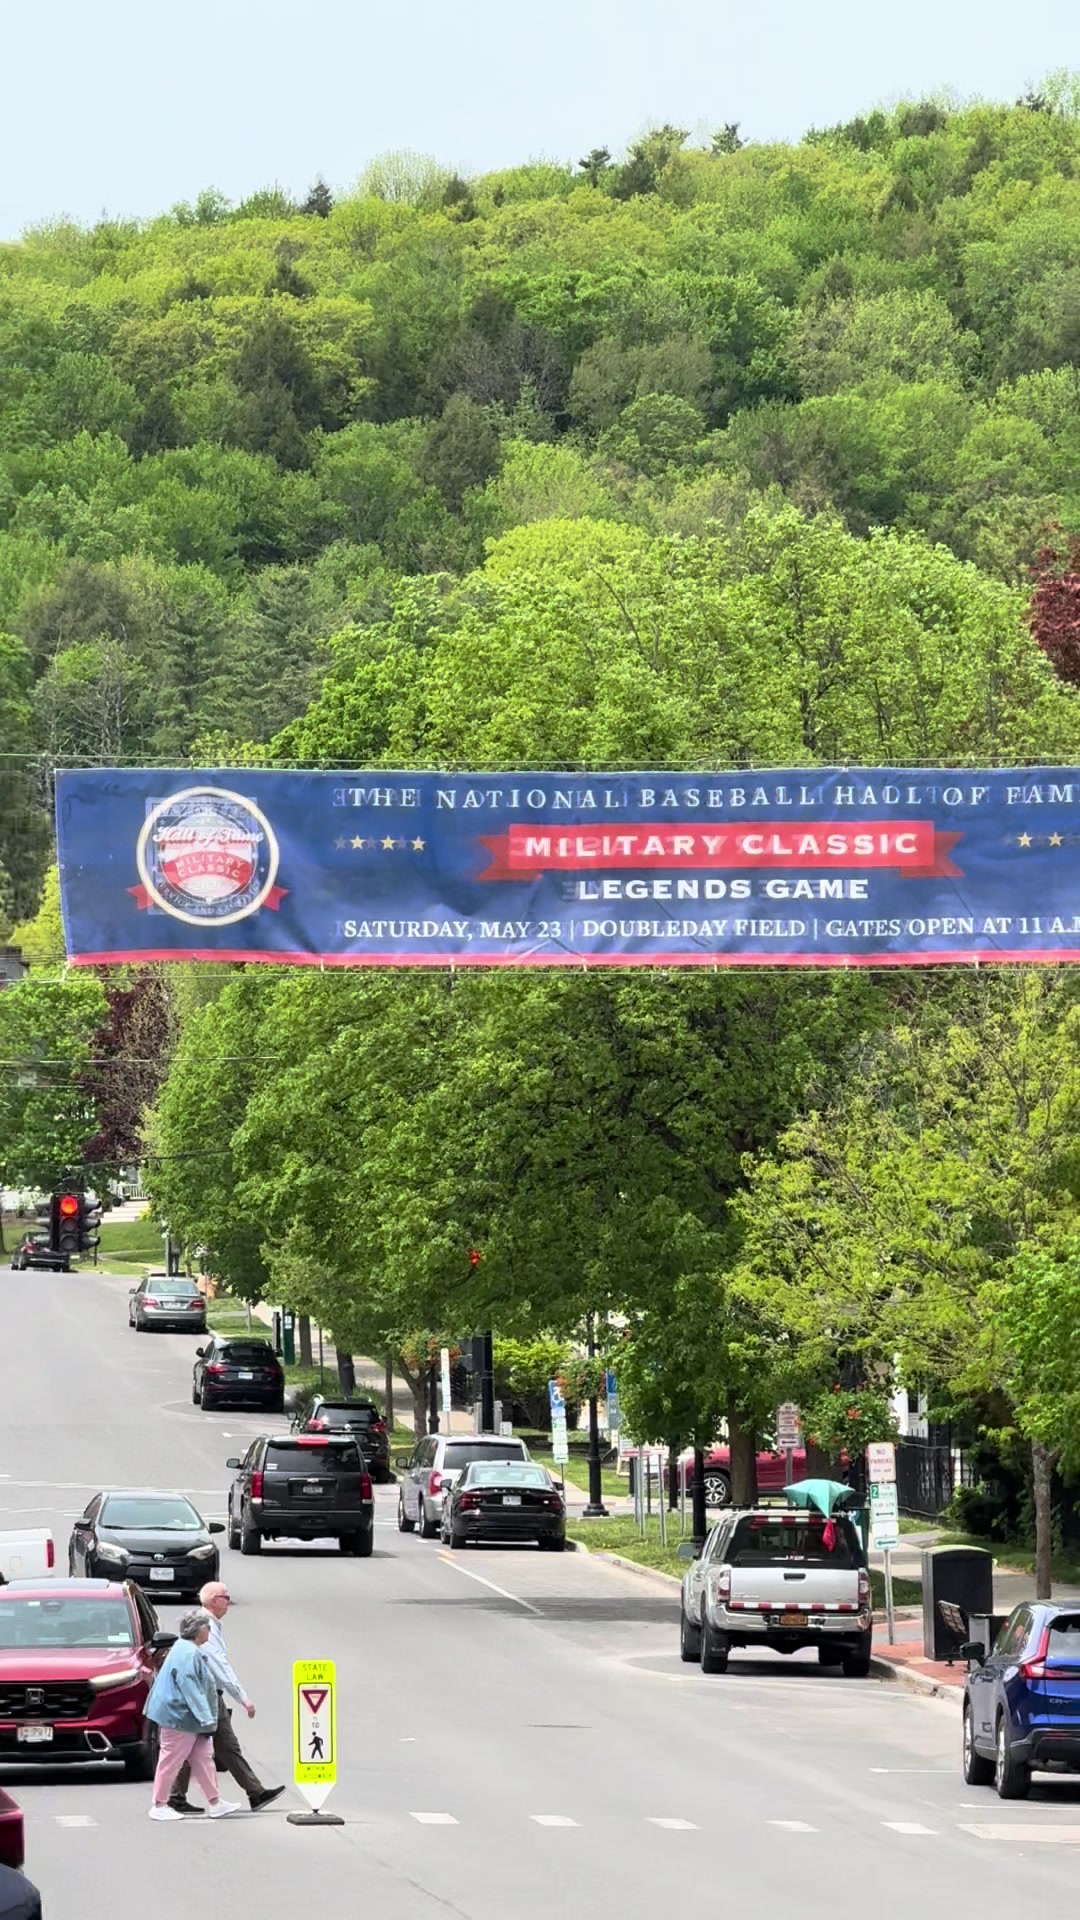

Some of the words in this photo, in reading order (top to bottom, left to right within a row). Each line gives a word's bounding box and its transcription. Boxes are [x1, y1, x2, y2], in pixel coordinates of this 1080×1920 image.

[349, 787, 416, 807] THE
[437, 788, 619, 809] NATIONAL
[640, 786, 815, 808] BASEBALL
[834, 785, 922, 805] HALL
[943, 786, 985, 806] OF
[1006, 784, 1074, 805] FAM
[152, 825, 197, 843] Hall
[198, 826, 219, 847] of
[219, 826, 265, 845] Fame
[526, 835, 721, 857] MILITARY
[742, 833, 918, 855] CLASSIC
[175, 853, 245, 868] MILITARY
[177, 863, 241, 878] CLASSIC
[579, 879, 752, 900] LEGENDS
[766, 879, 869, 899] GAME
[344, 920, 472, 941] SATURDAY,
[480, 921, 530, 939] MAY
[537, 920, 562, 938] 23
[583, 919, 728, 938] DOUBLEDAY
[735, 918, 806, 937] FIELD
[826, 919, 900, 937] GATES
[909, 917, 974, 937] OPEN
[982, 917, 1012, 935] AT
[1020, 917, 1043, 934] 11
[876, 1448, 886, 1456] NO
[302, 1663, 328, 1672] STATE
[306, 1673, 324, 1681] LAW
